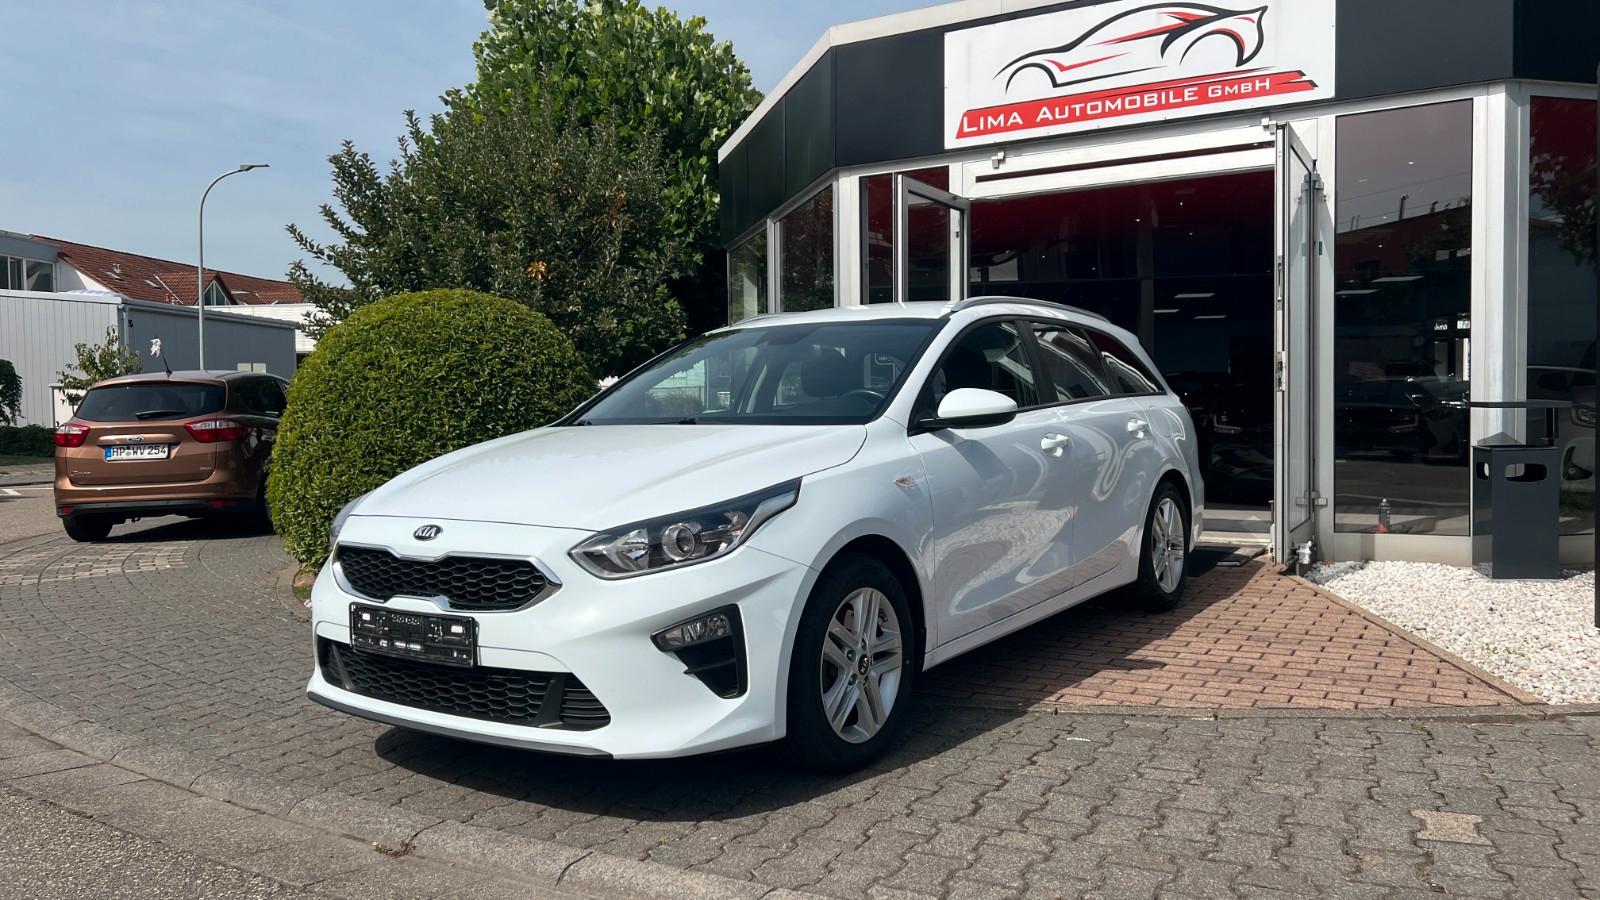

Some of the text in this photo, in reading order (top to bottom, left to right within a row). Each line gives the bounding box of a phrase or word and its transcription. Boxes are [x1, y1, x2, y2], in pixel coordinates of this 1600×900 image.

[962, 111, 1024, 133] LIMA
[1036, 87, 1198, 122] AUTOMOBILE
[147, 444, 167, 455] 254
[415, 526, 438, 537] KIA
